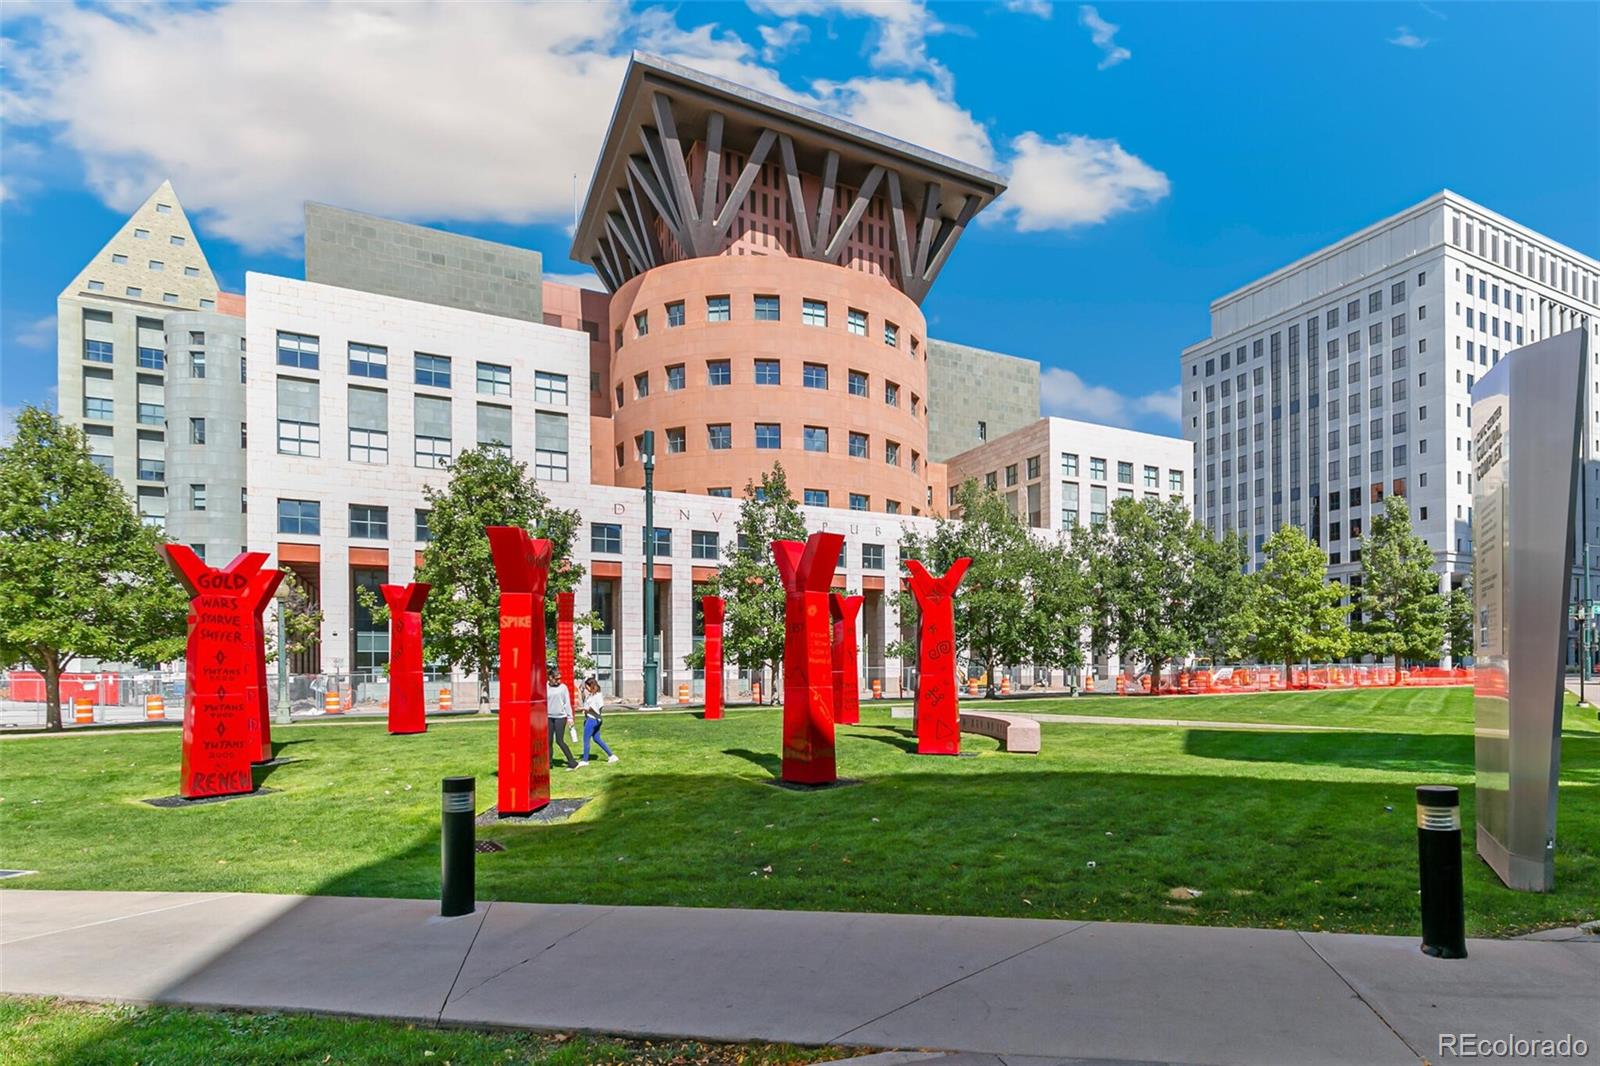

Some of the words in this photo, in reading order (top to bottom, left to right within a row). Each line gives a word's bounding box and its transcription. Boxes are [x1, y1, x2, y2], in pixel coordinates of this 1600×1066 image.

[1476, 423, 1503, 463] CULTURAL
[1476, 442, 1503, 482] COMPLEX
[198, 573, 249, 590] GOLD
[201, 597, 239, 610] WARS
[201, 612, 241, 627] STARVE
[500, 615, 532, 629] SPIKE
